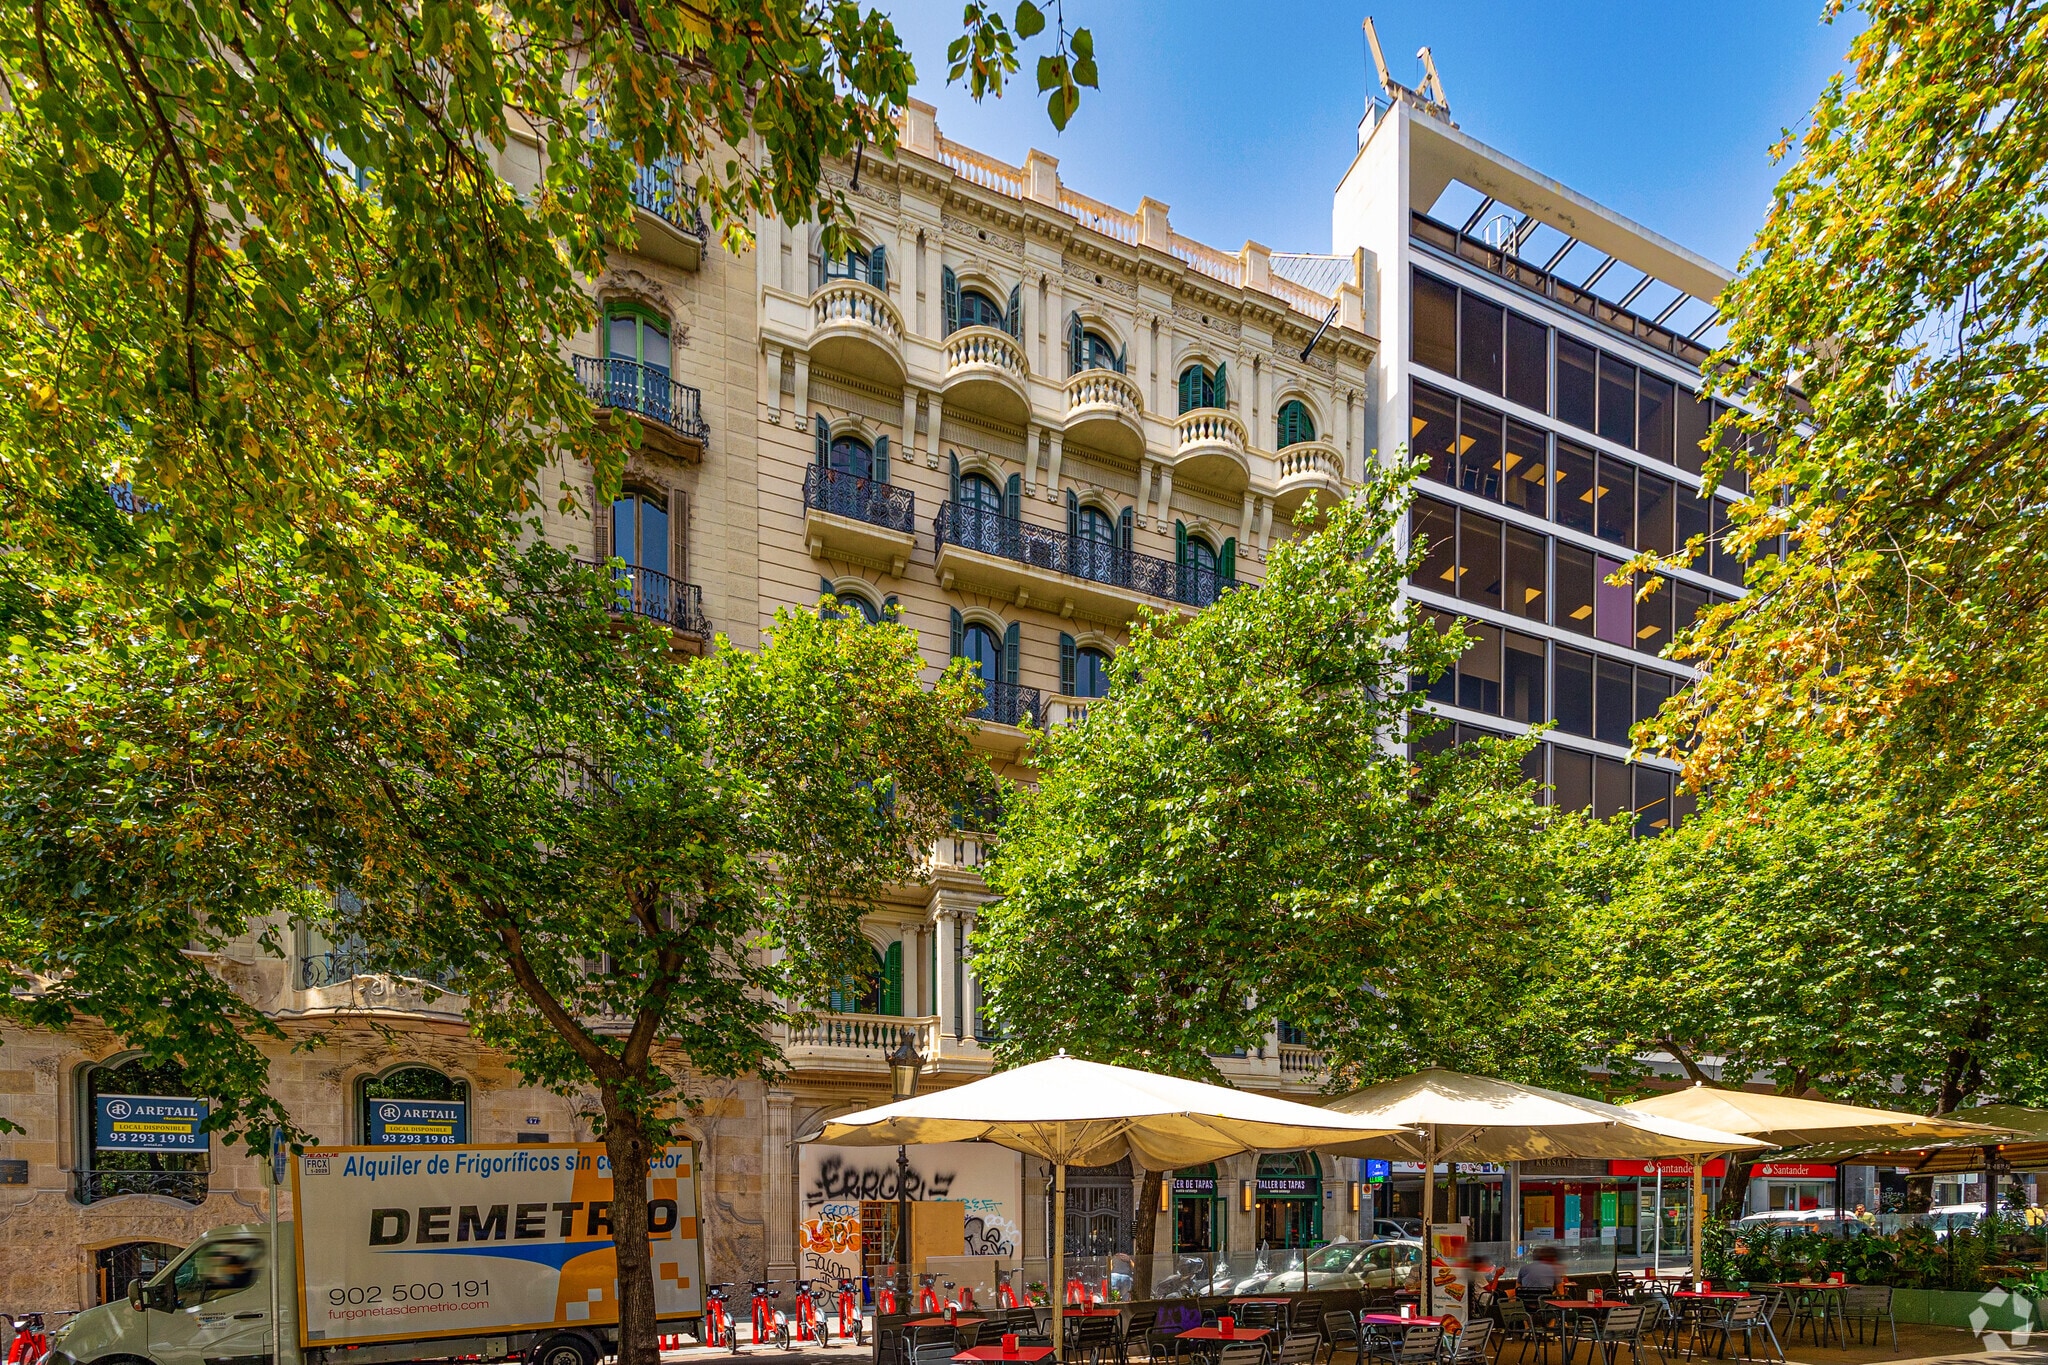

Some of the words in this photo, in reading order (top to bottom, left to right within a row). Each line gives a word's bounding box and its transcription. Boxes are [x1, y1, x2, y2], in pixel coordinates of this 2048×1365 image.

[135, 1106, 198, 1117] ARETAIL
[403, 1109, 458, 1119] ARETAIL
[110, 1133, 127, 1142] 93
[130, 1133, 156, 1143] 293
[159, 1134, 176, 1143] 19
[179, 1134, 195, 1144] 05
[382, 1134, 397, 1143] 93
[399, 1135, 421, 1143] 293
[424, 1135, 438, 1144] 19
[441, 1135, 455, 1144] 05
[306, 1159, 328, 1169] FRCX
[343, 1153, 422, 1182] Alquiler
[426, 1154, 450, 1175] de
[455, 1150, 560, 1179] Frigoríficos
[565, 1152, 591, 1171] sin
[597, 1153, 682, 1170] coctor
[1656, 1162, 1695, 1174] Santande
[1773, 1164, 1809, 1175] Santander
[1173, 1180, 1184, 1189] LER
[1185, 1180, 1194, 1189] DE
[1195, 1180, 1213, 1189] TAPAS
[1258, 1180, 1278, 1189] TALLER
[1279, 1180, 1287, 1189] DE
[1288, 1180, 1305, 1189] TAPAS
[368, 1198, 679, 1247] DEMETRO
[328, 1286, 383, 1306] 902
[392, 1282, 444, 1302] 500
[451, 1279, 490, 1298] 191
[328, 1300, 489, 1321] furgonetasdemetrio.com
